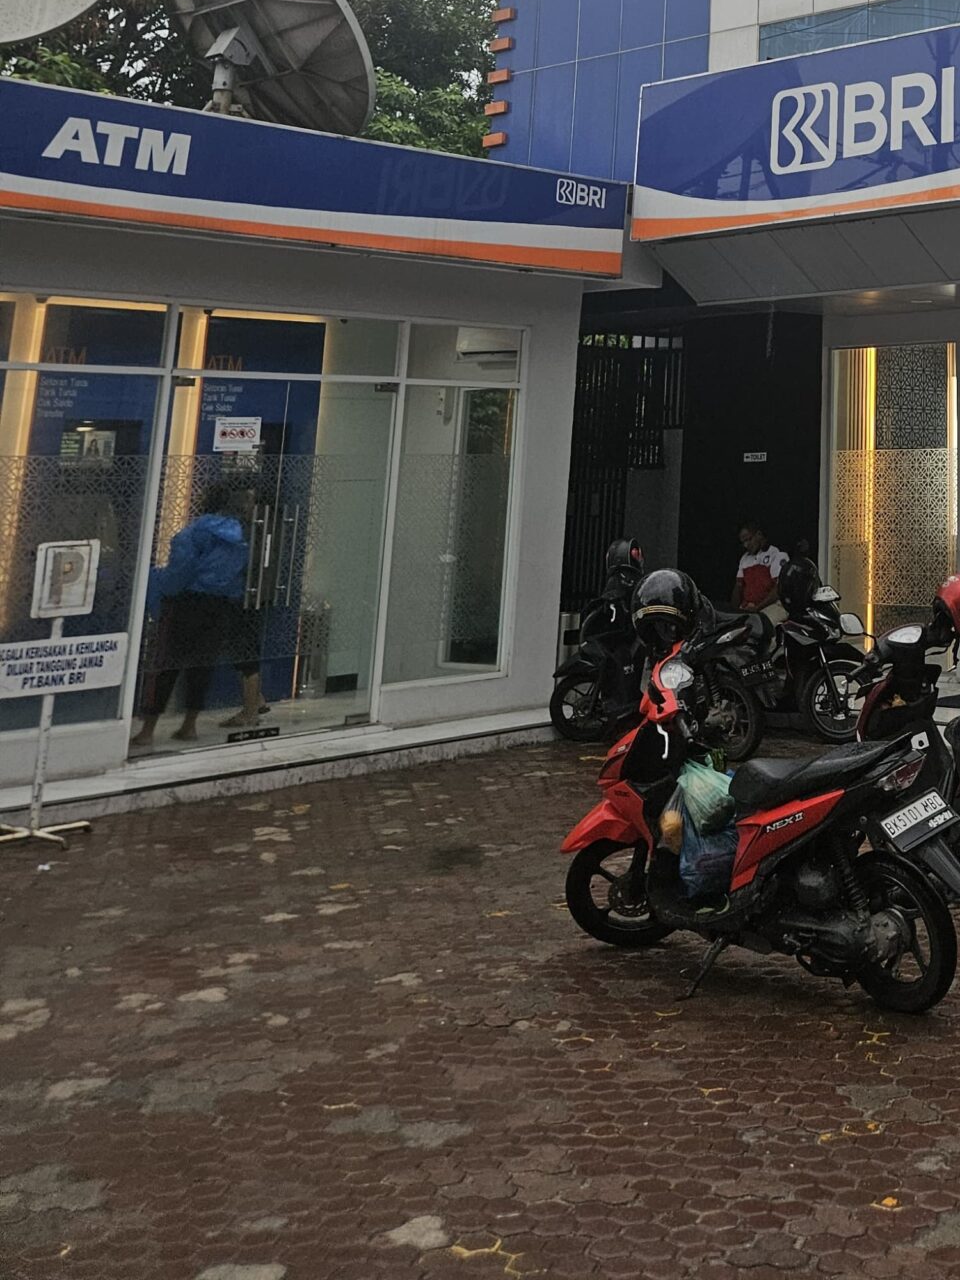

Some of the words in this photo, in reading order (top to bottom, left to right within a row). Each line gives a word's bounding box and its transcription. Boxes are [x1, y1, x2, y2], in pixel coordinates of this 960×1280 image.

[842, 66, 955, 159] BRI
[41, 116, 192, 176] ATM
[575, 184, 606, 209] BRI
[206, 354, 244, 372] ATM
[48, 549, 85, 606] P
[26, 644, 67, 660] KERUSAKAN
[75, 640, 119, 655] KEHILANGAN
[6, 661, 34, 677] DILUAR
[36, 658, 77, 673] TANGGUNG
[79, 655, 104, 670] JAWAB
[68, 671, 86, 685] BRI
[766, 815, 794, 833] NEX
[884, 806, 923, 836] BK5101
